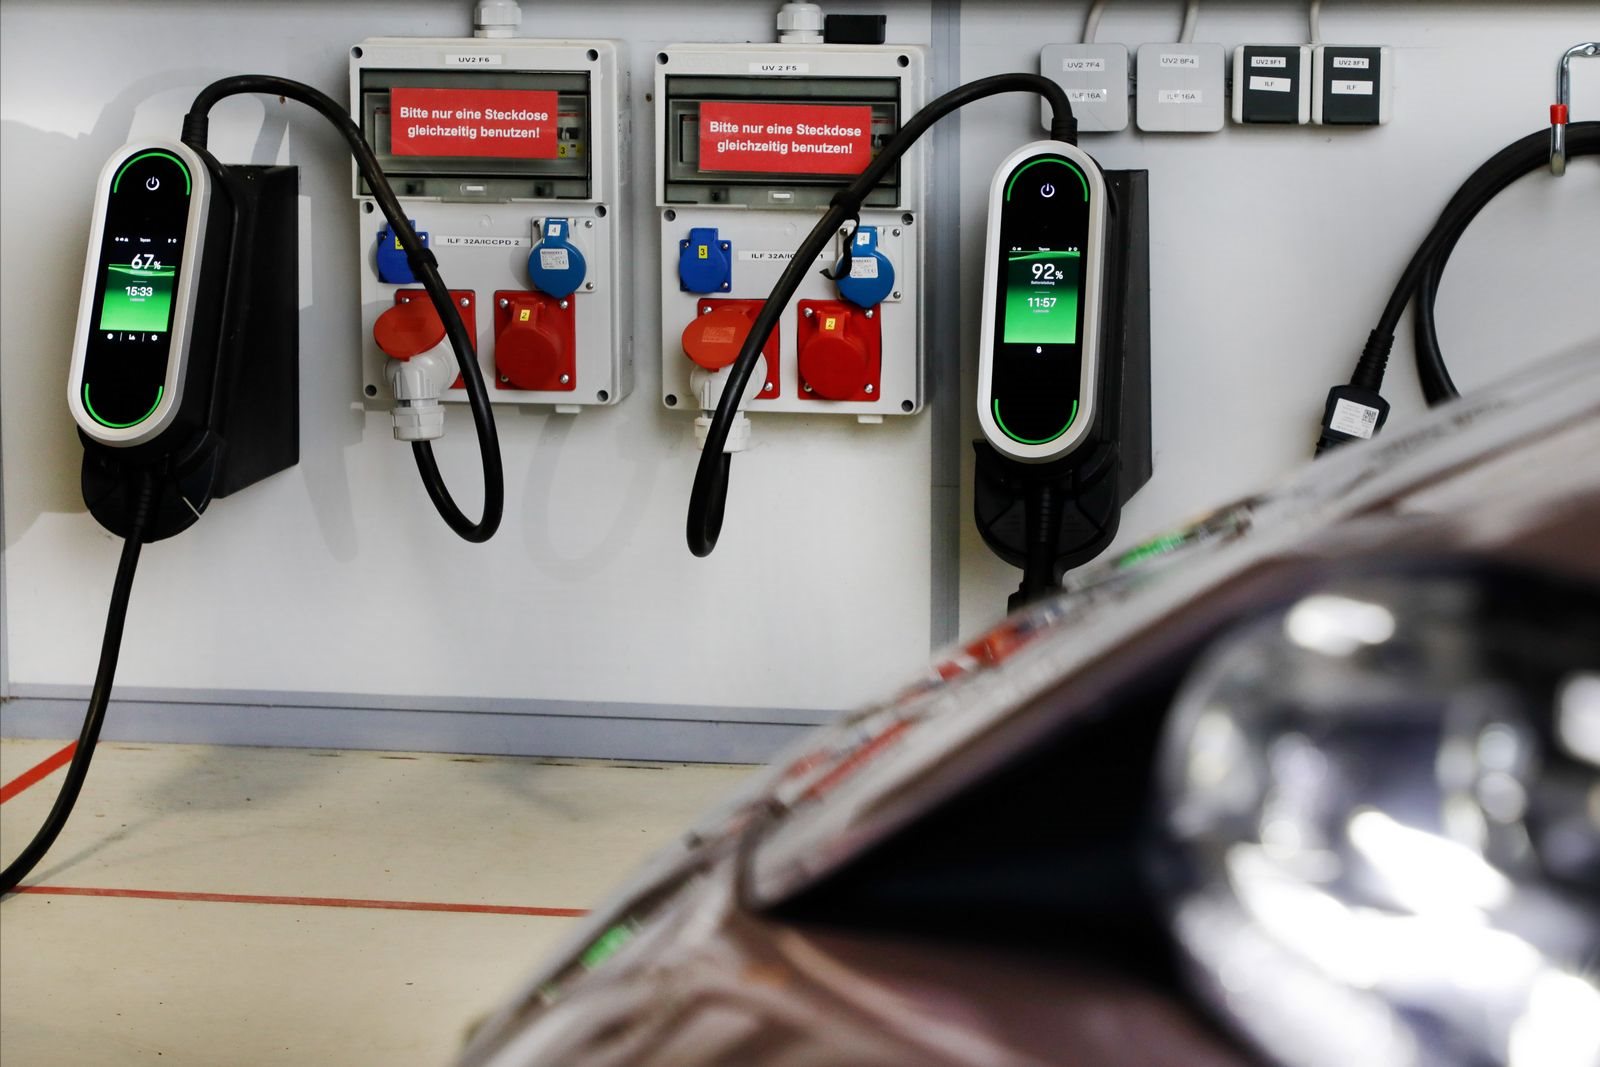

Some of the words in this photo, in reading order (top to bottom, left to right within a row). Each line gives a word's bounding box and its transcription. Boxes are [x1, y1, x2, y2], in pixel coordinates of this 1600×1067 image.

[400, 107, 428, 119] Bitte
[432, 109, 452, 120] nur
[456, 108, 481, 120] eine
[484, 109, 548, 121] Steckdose
[408, 125, 477, 140] gleichzeitig
[480, 127, 540, 138] benutzen!
[710, 121, 739, 133] Bitte
[742, 124, 764, 134] nur
[766, 123, 792, 134] eine
[796, 124, 862, 136] Steckdose
[717, 140, 788, 154] gleichzeitig
[792, 142, 852, 154] benutzen!
[700, 248, 706, 256] 3
[131, 254, 160, 270] 67%
[1032, 263, 1064, 280] 92%
[125, 286, 153, 296] 15:33
[1027, 298, 1057, 308] 11:57
[522, 311, 528, 319] 2
[828, 320, 834, 328] 2
